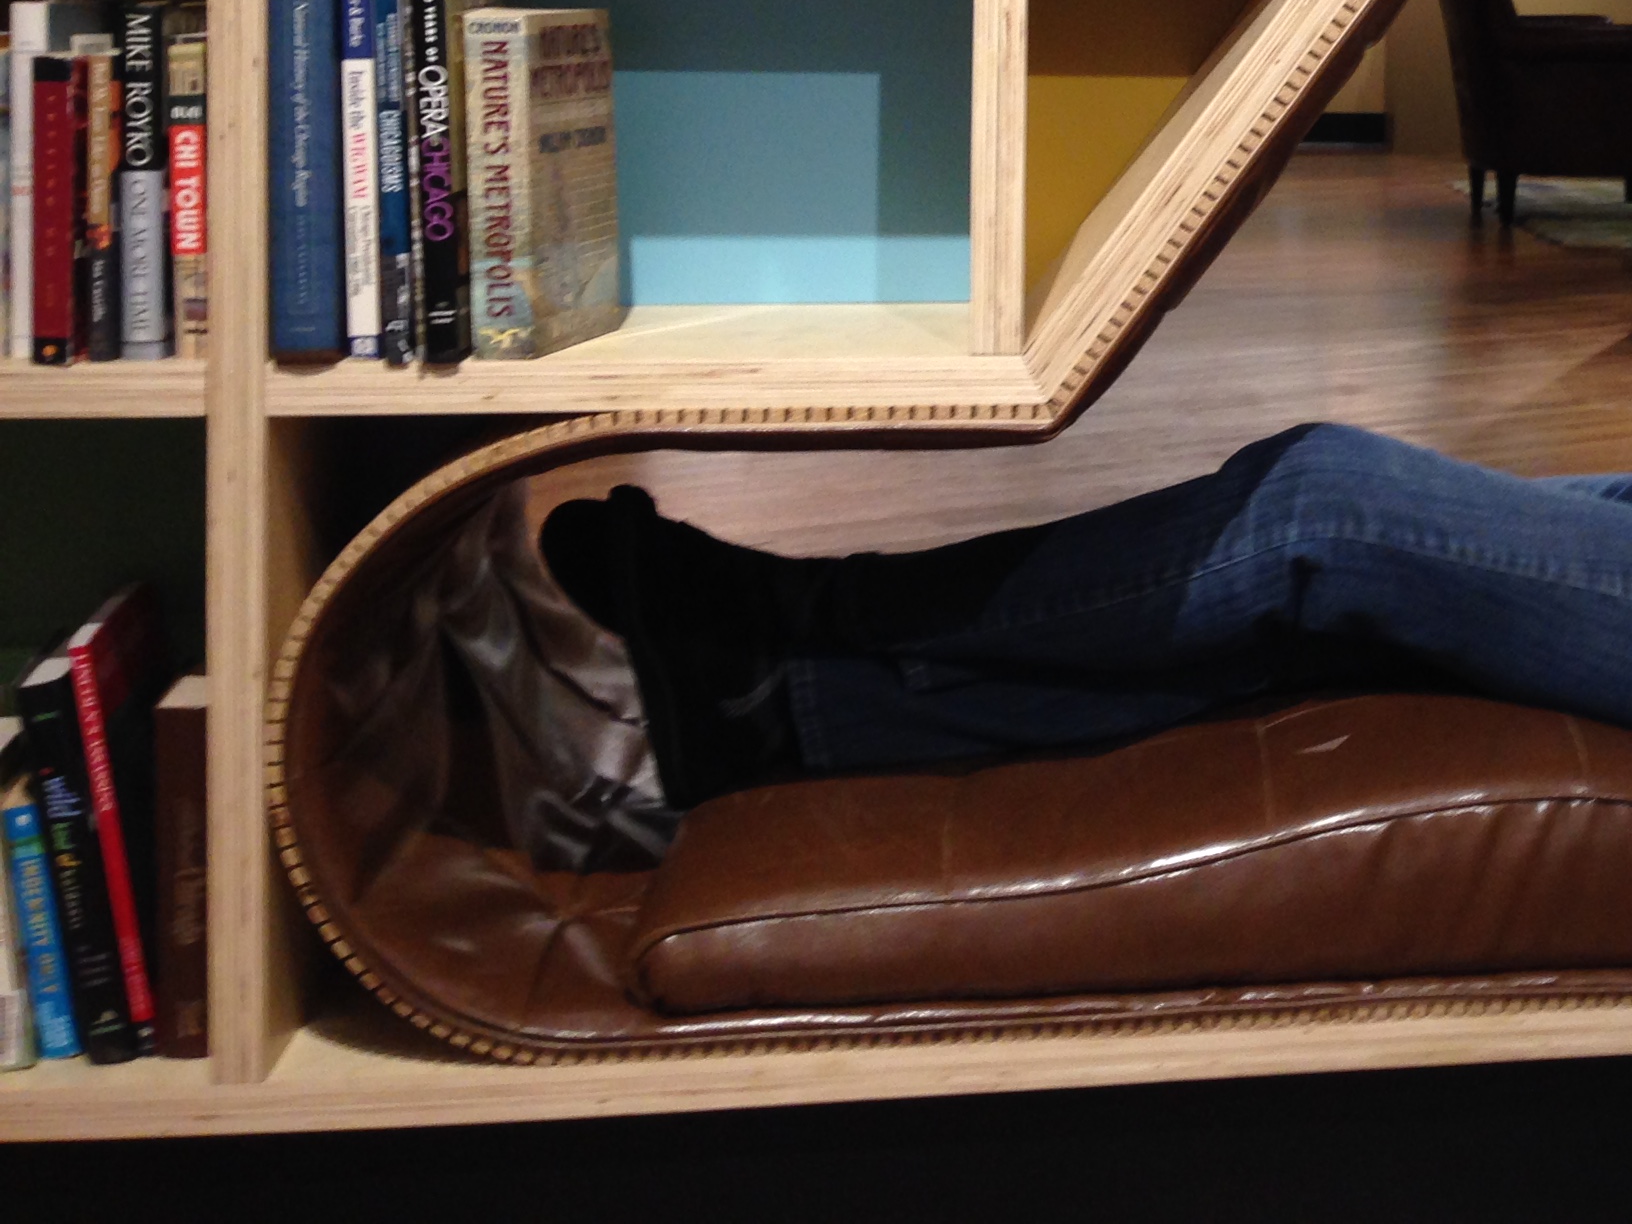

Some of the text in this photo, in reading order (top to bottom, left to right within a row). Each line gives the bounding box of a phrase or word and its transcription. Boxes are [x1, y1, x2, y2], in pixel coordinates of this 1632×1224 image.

[125, 13, 154, 167] MIKE ROYKO
[350, 111, 367, 130] the
[176, 130, 200, 167] CHI
[350, 133, 370, 199] WIGWAM
[379, 110, 404, 193] CHICAGOISMS
[418, 65, 454, 242] OPERA CHICAGO
[481, 40, 514, 318] NATURE'S METROPOLIS
[175, 176, 200, 250] TOWN
[129, 180, 149, 332] ONE MORE TIME
